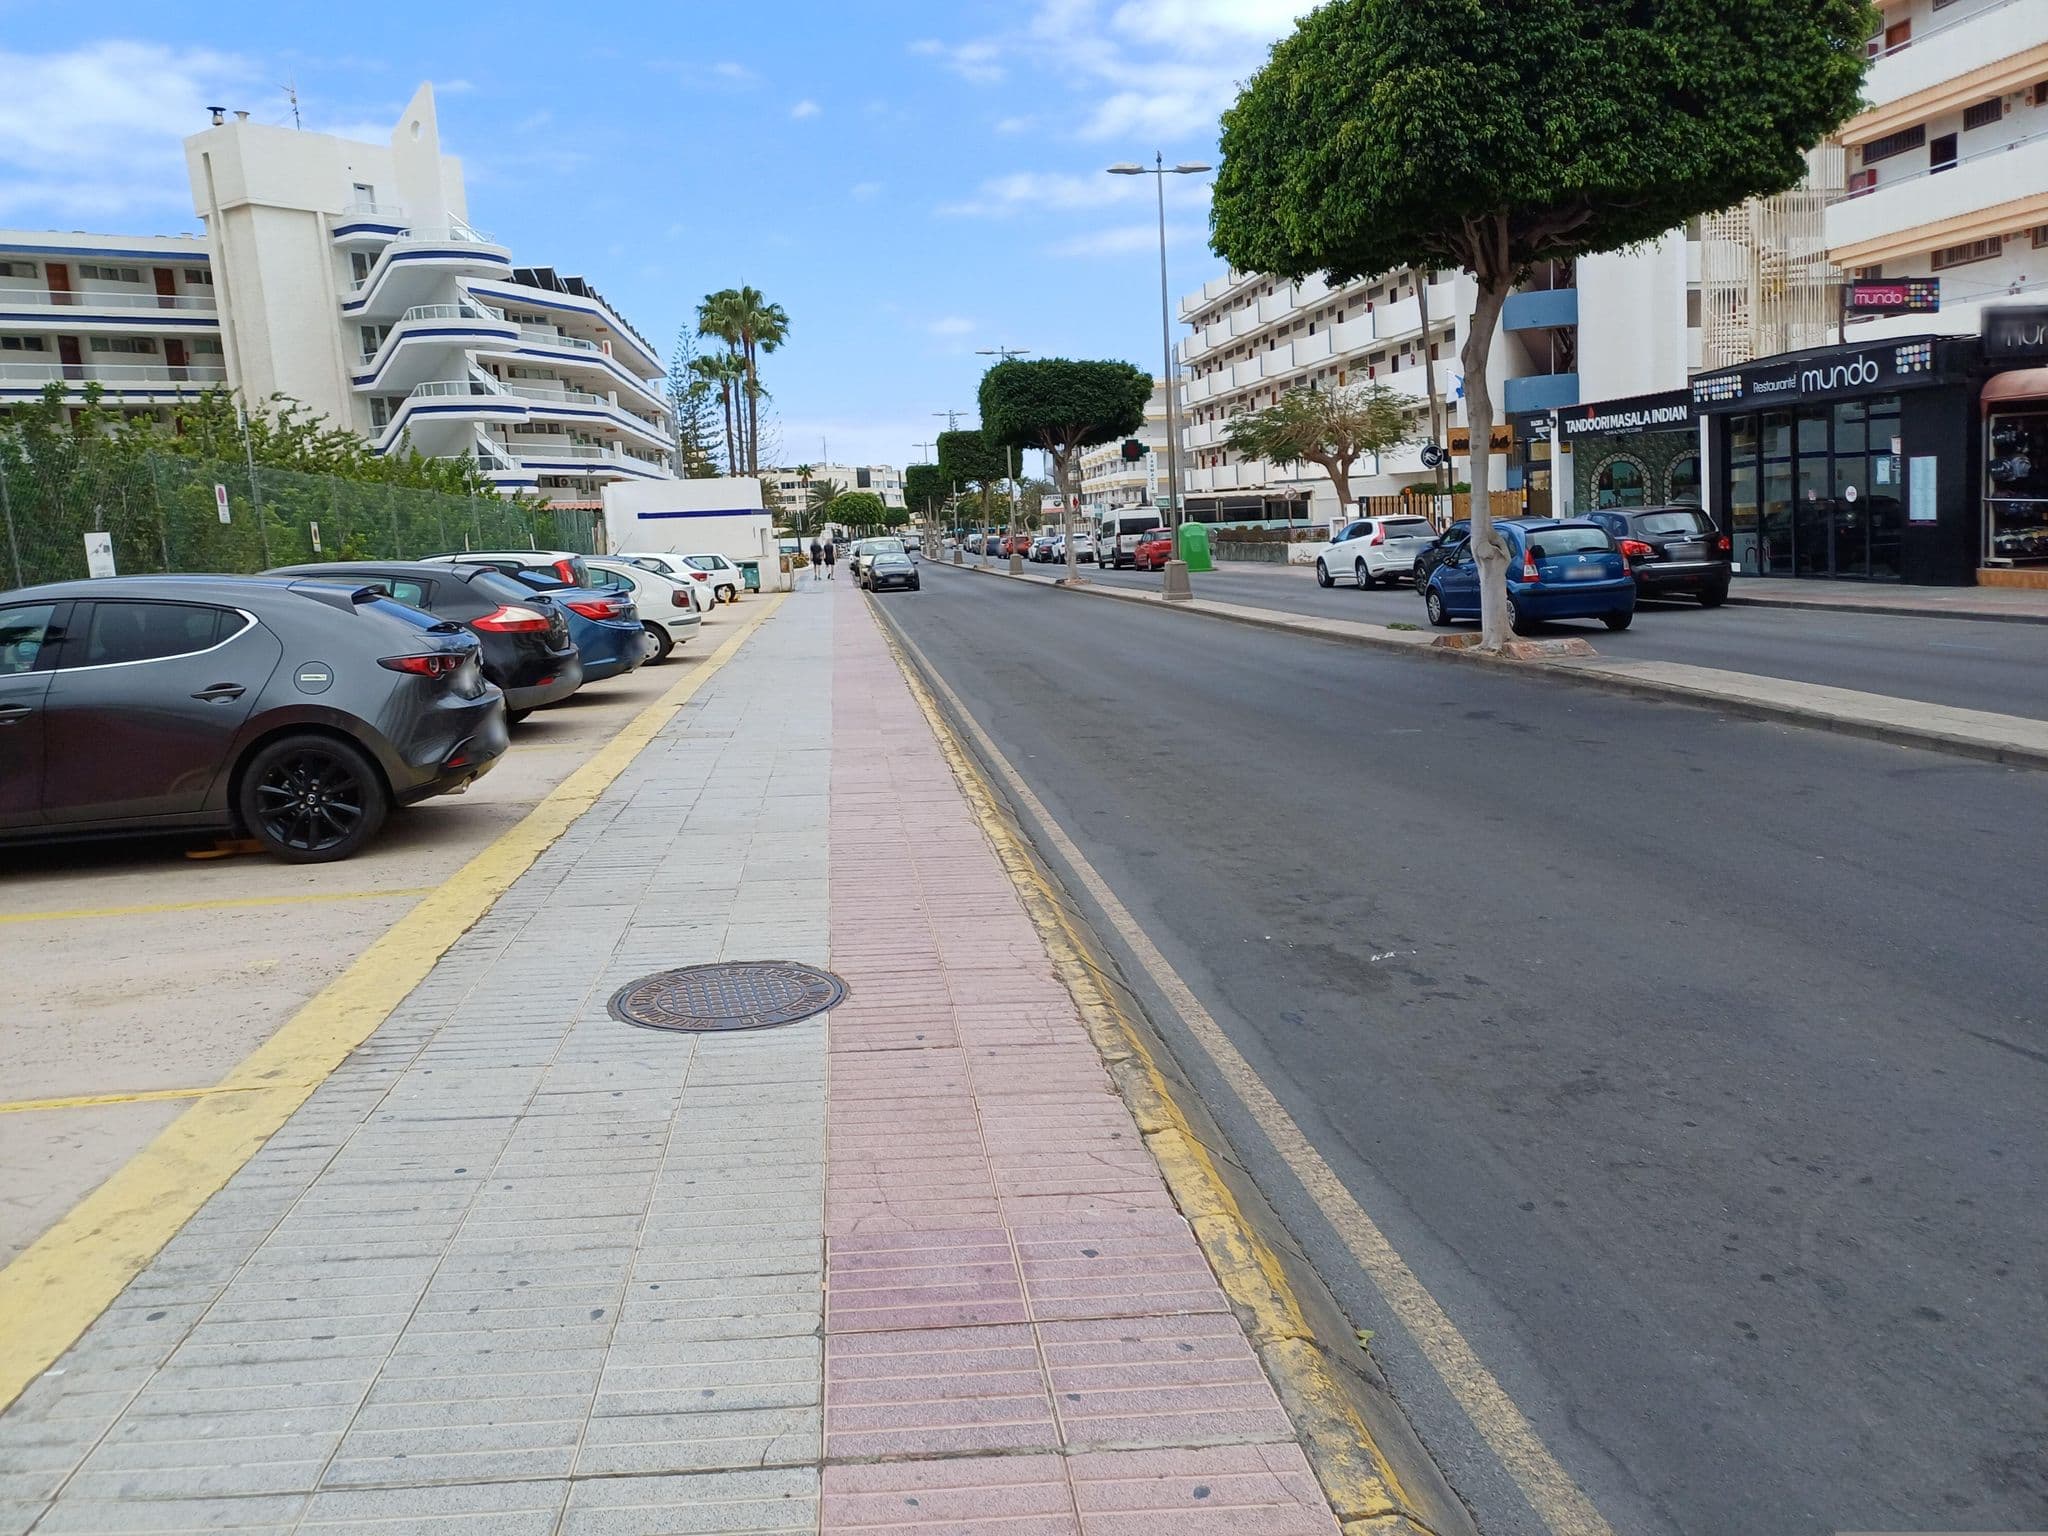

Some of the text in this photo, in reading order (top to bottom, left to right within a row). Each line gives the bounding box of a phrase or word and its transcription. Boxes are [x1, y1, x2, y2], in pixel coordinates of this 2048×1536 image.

[1854, 291, 1902, 304] mundo
[1753, 355, 1878, 393] Restaurante mundo
[1565, 414, 1610, 433] TANDOORI
[1610, 410, 1651, 428] MASALA
[1652, 405, 1687, 424] INDIAN
[738, 1014, 774, 1025] DE
